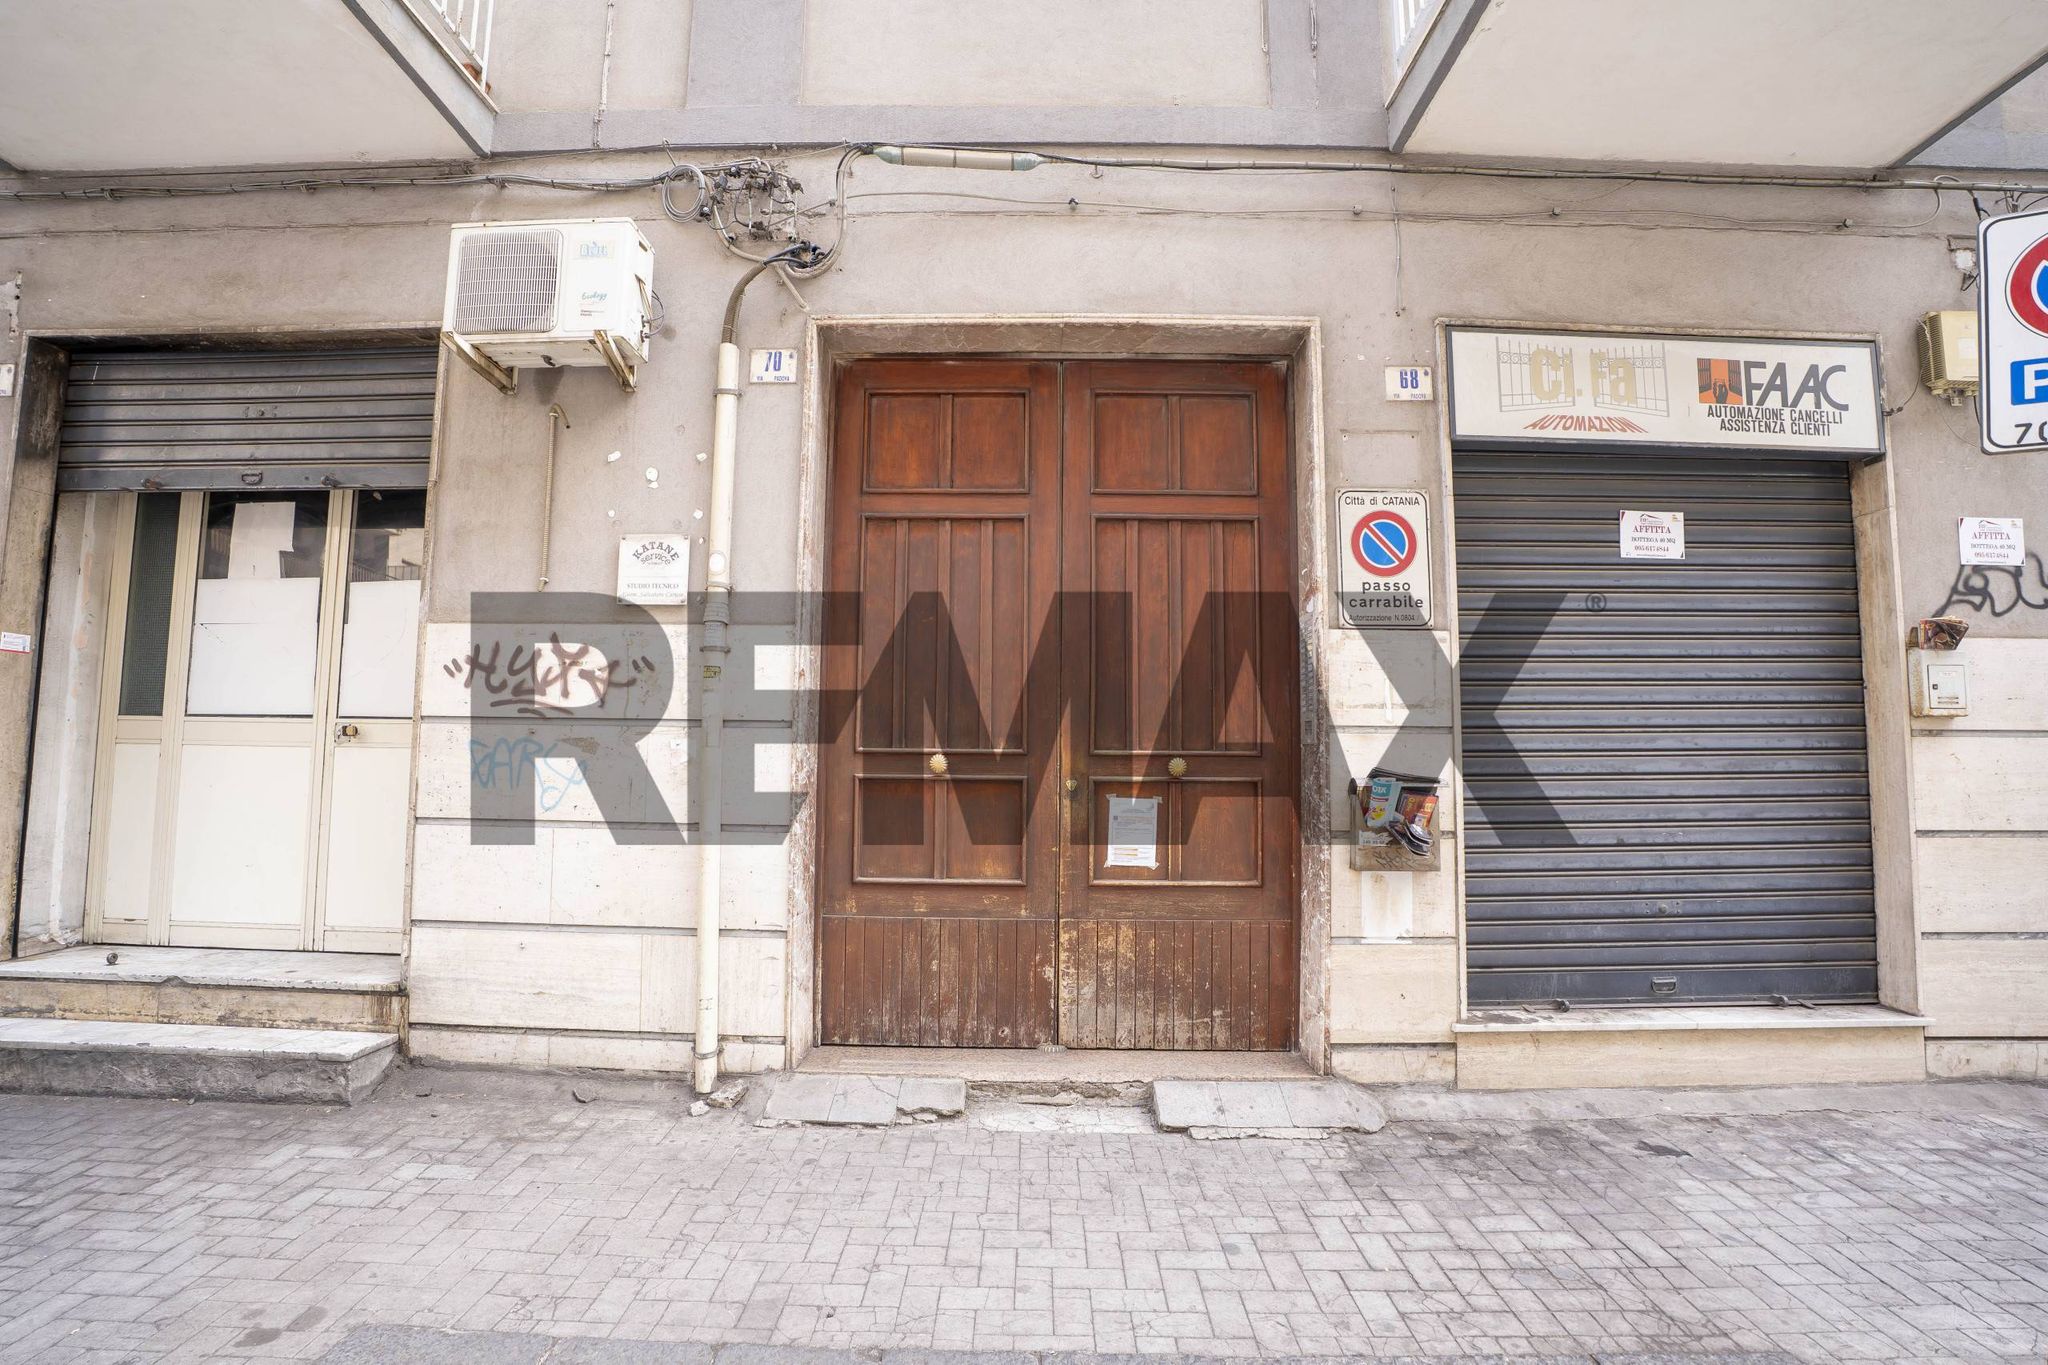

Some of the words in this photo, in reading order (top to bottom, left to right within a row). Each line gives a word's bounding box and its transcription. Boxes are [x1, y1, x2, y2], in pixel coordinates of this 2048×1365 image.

[764, 351, 782, 371] 70
[1400, 369, 1419, 389] 68
[1743, 361, 1849, 411] FAAC
[1523, 414, 1649, 433] AUTOMAZIONI
[1707, 405, 1785, 421] AUTOMAZIONE
[1790, 409, 1843, 424] CANCELLI
[1720, 419, 1786, 434] ASSISTENZA
[1791, 422, 1831, 436] CLIENTI
[1344, 496, 1365, 505] Città
[1370, 496, 1378, 505] di
[1382, 496, 1420, 506] CATANIA
[1632, 525, 1671, 533] AFFITTA
[1972, 532, 2011, 540] AFFITTA
[632, 541, 679, 560] KATANE
[1362, 581, 1411, 594] passo
[1349, 595, 1424, 608] carrabile
